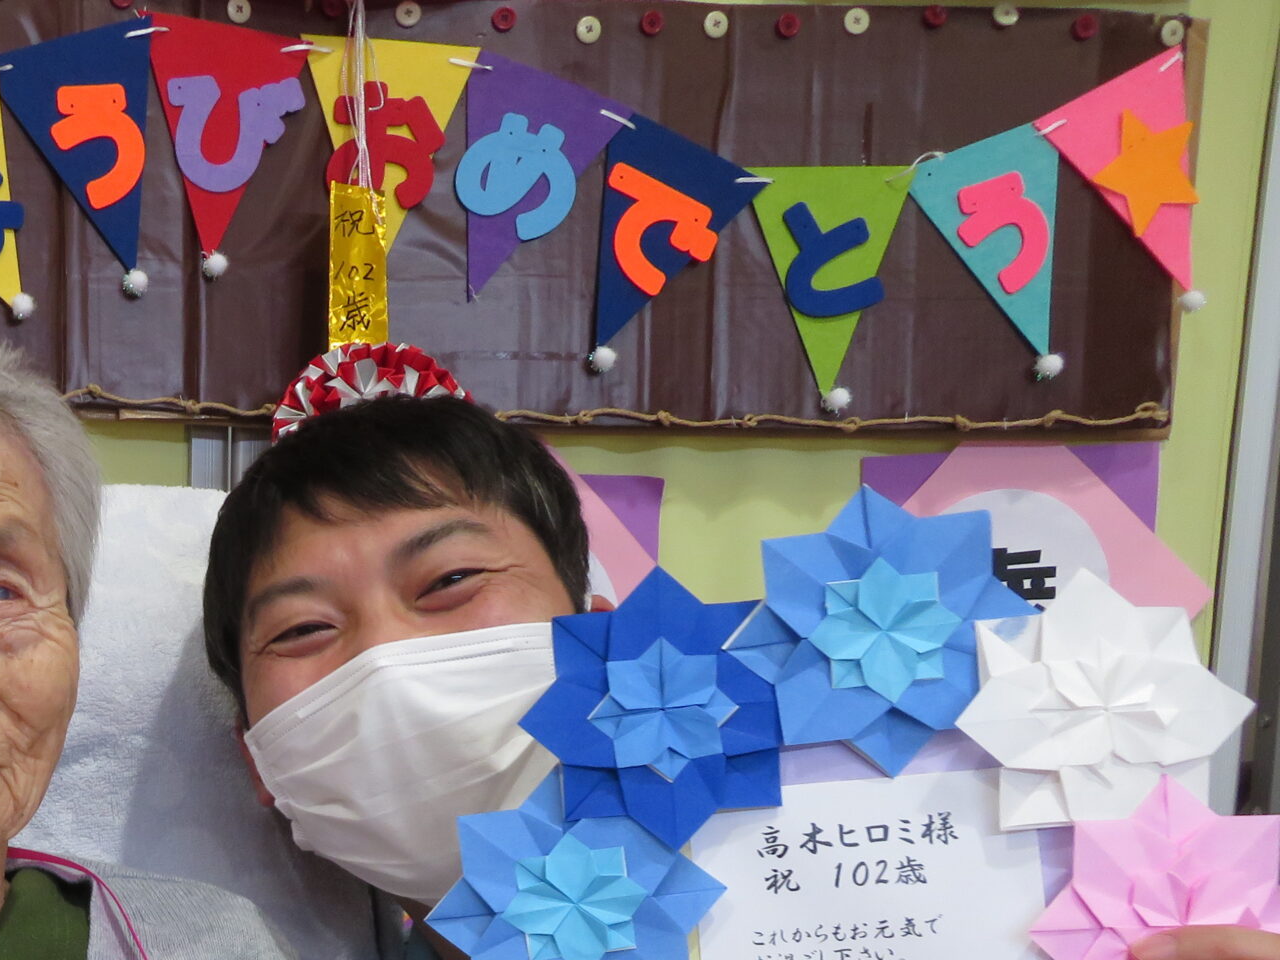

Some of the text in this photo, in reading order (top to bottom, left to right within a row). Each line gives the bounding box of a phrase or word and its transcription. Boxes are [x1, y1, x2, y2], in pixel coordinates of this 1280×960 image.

[334, 209, 375, 238] 祝
[756, 811, 959, 859] 高木ヒロミ様
[764, 856, 928, 895] 祝 102歳
[751, 914, 944, 946] これからもお元気で
